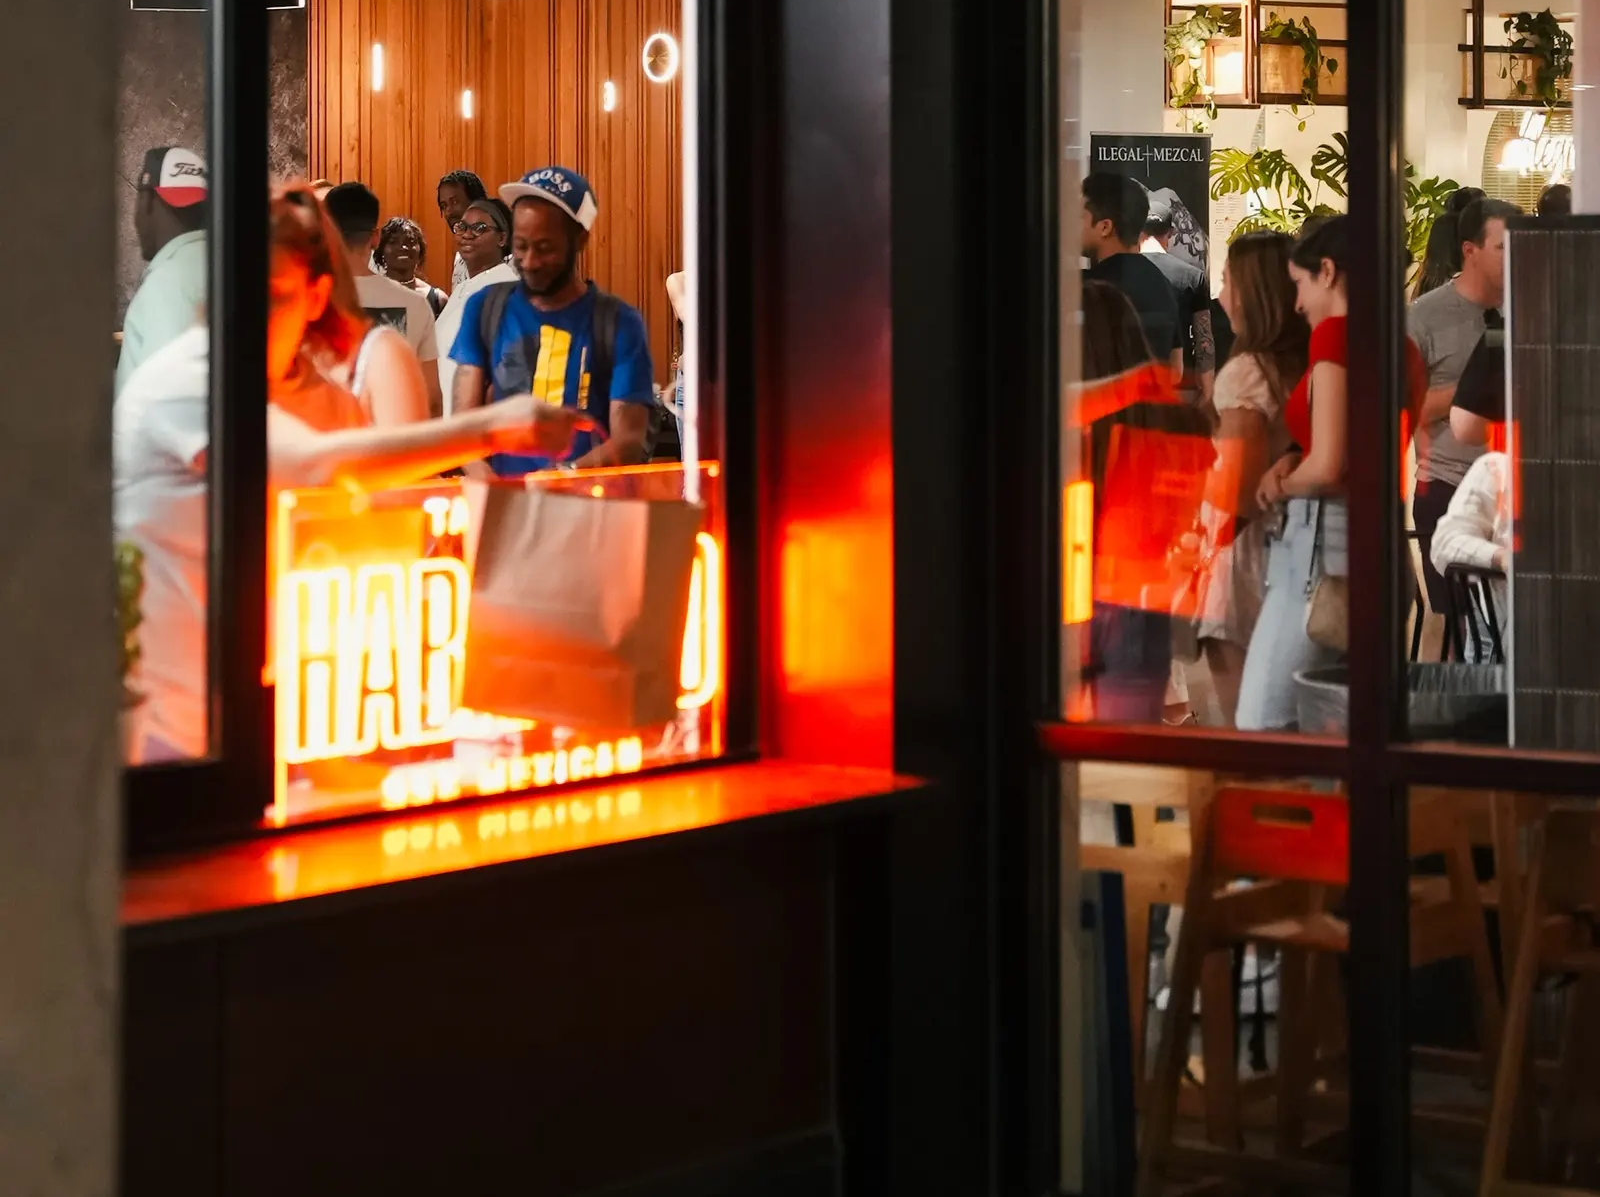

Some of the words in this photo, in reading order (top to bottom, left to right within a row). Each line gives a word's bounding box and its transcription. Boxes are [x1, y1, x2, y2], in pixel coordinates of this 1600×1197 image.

[1098, 146, 1144, 162] ILEGAL
[1153, 147, 1204, 162] MEZCAL
[528, 169, 572, 193] BOSS
